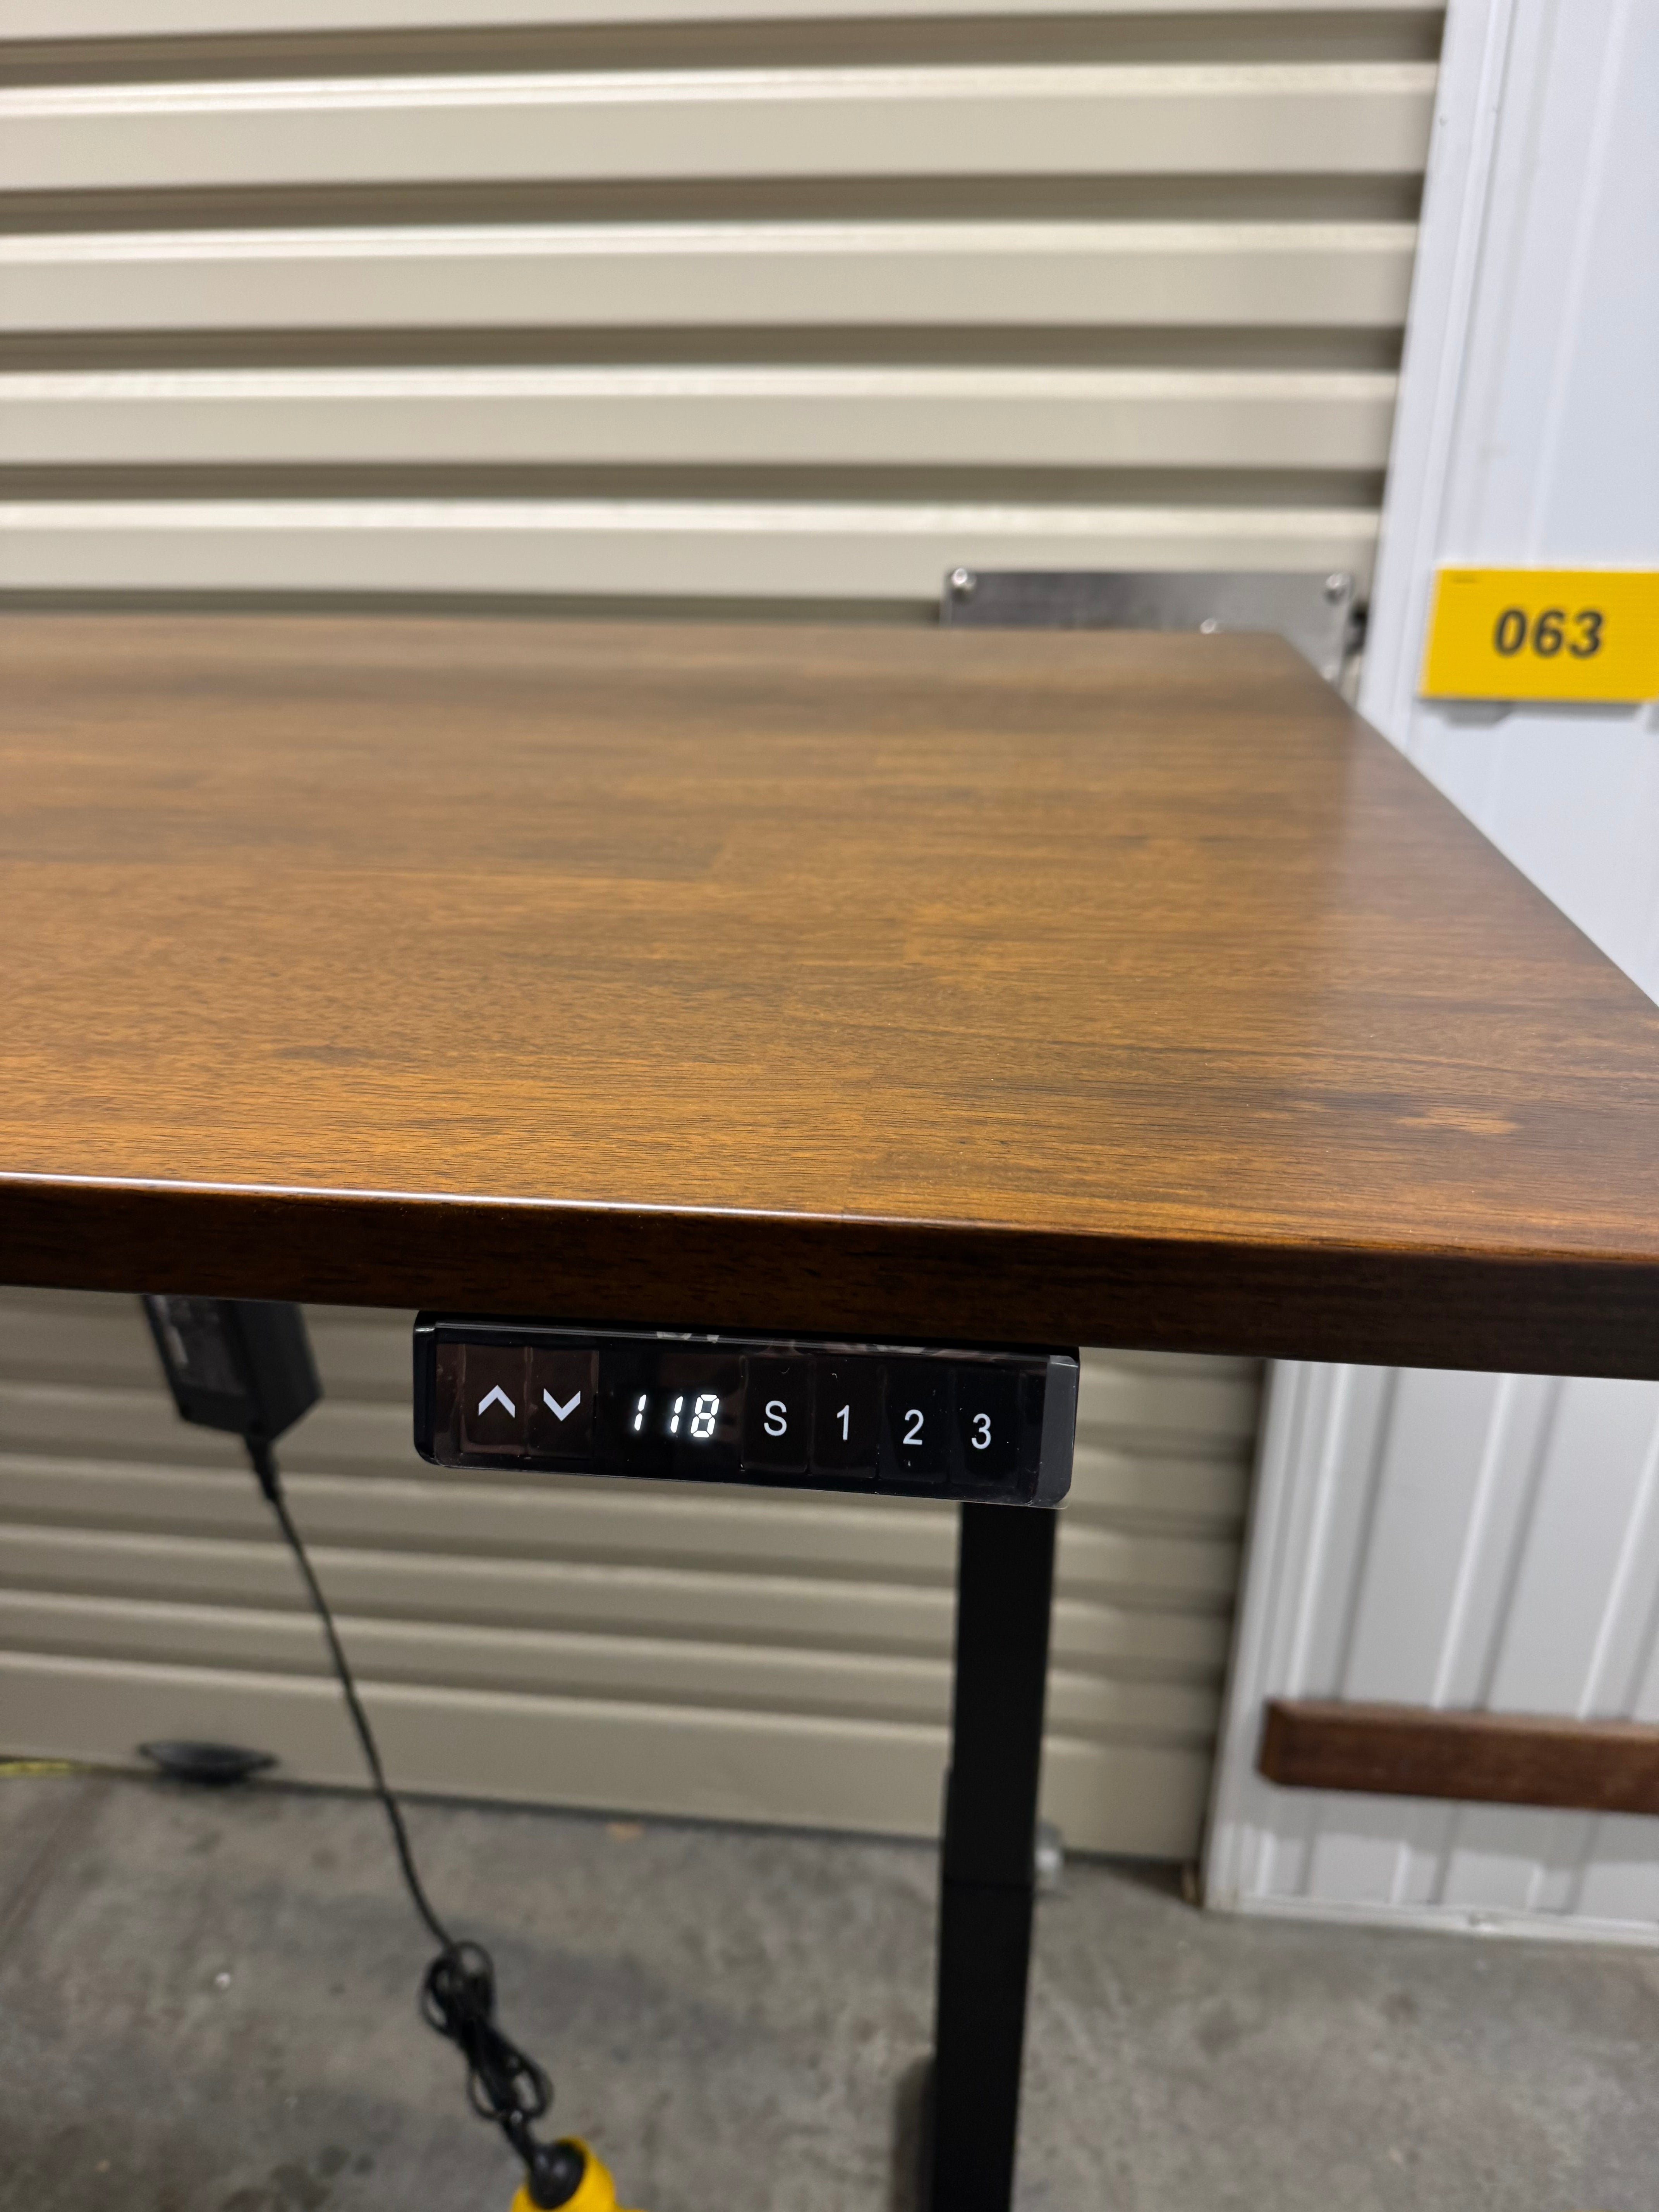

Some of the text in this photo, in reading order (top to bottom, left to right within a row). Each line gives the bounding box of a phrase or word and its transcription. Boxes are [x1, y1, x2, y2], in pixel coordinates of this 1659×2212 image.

[1494, 608, 1604, 658] 063
[634, 1394, 720, 1438] 118
[764, 1400, 991, 1449] S 1 2 3
